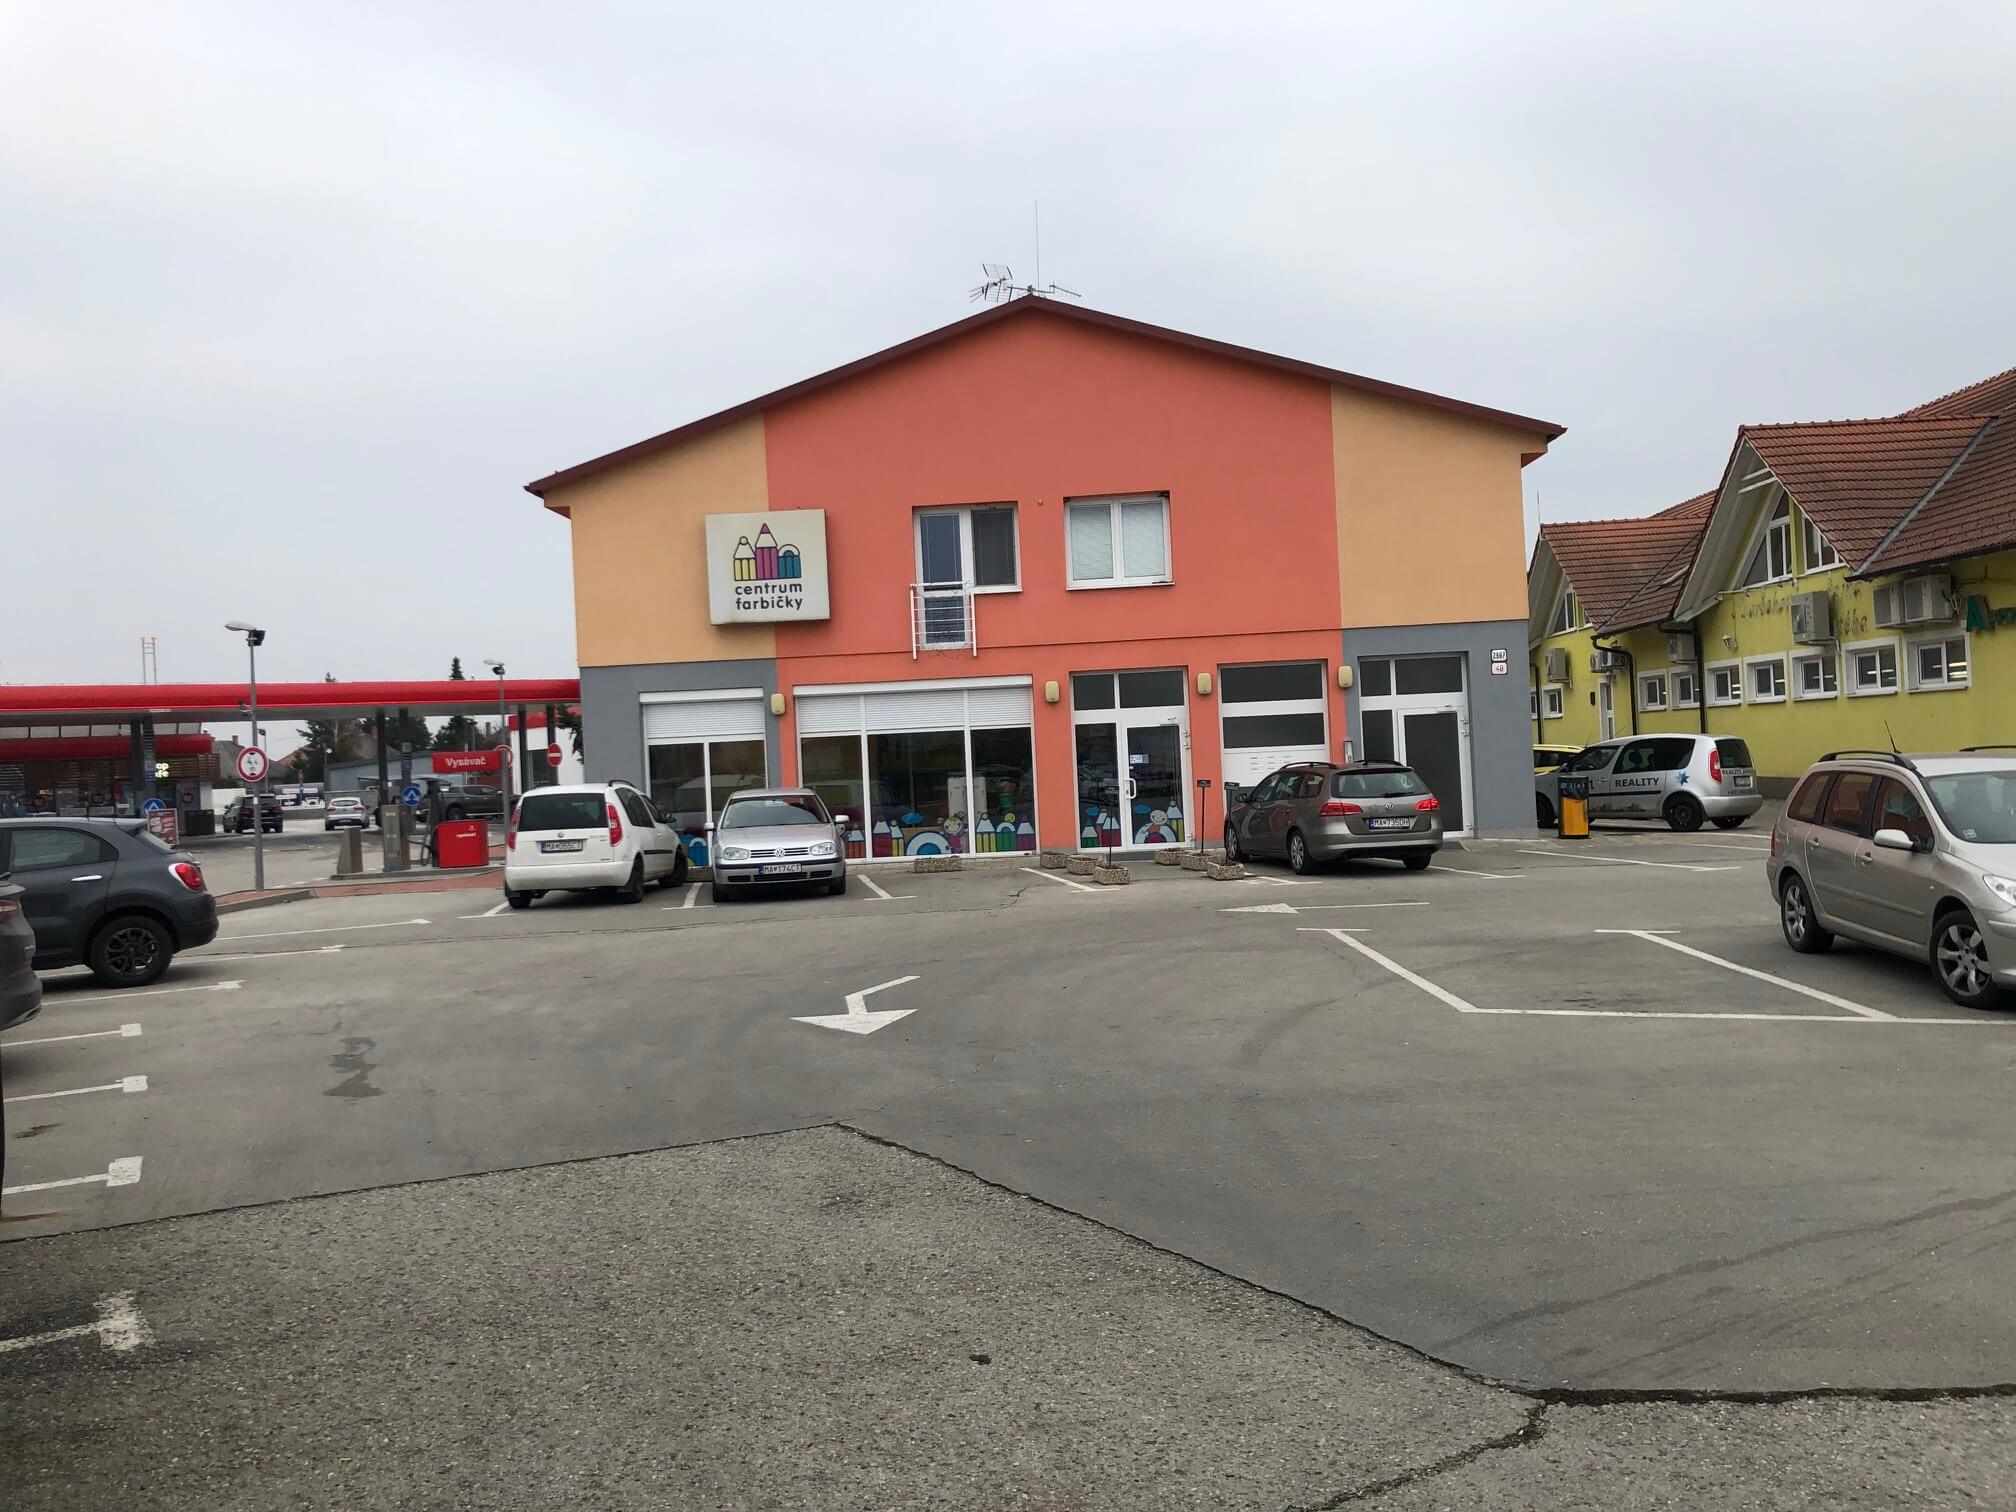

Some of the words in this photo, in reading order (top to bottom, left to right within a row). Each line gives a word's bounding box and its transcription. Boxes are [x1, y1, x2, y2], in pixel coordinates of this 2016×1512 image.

[735, 583, 802, 595] centrum
[736, 595, 803, 610] farbičky
[1615, 777, 1659, 787] REALITY
